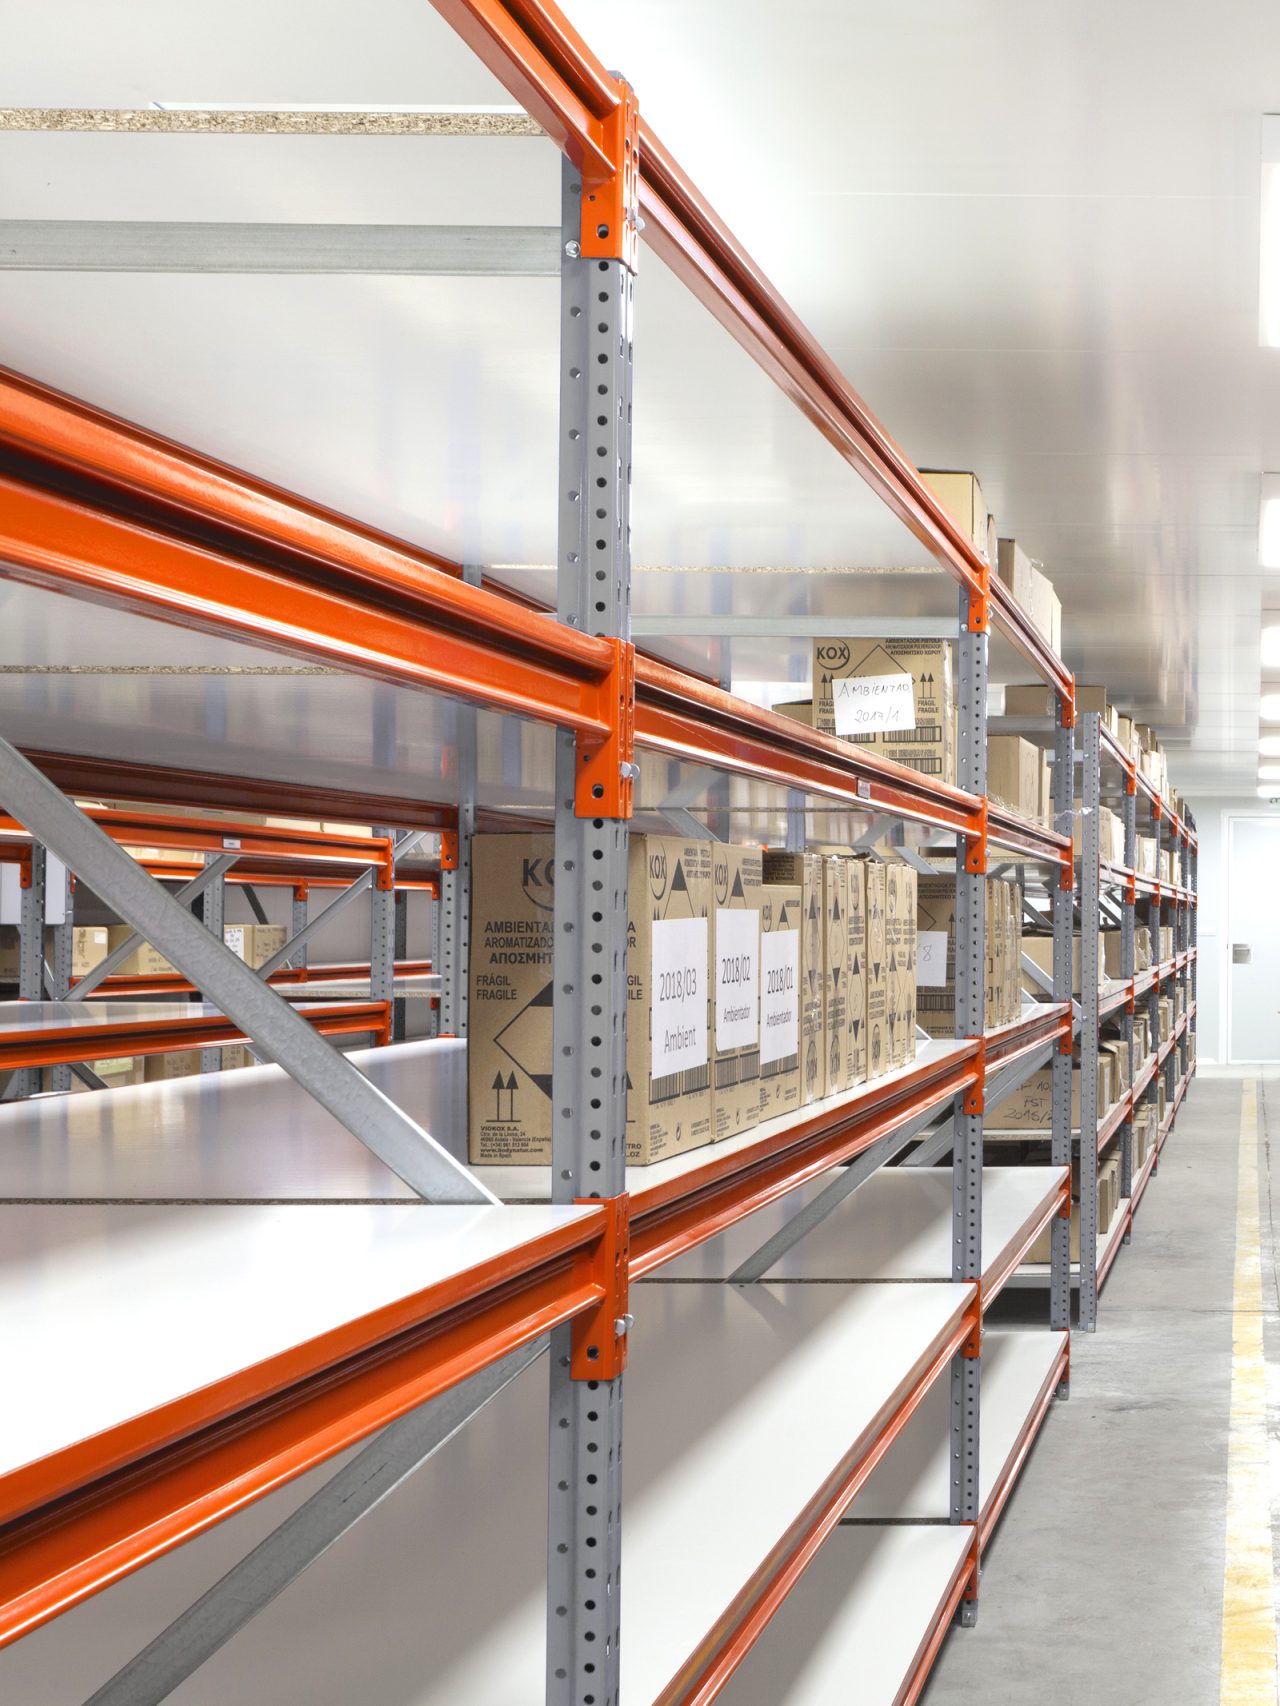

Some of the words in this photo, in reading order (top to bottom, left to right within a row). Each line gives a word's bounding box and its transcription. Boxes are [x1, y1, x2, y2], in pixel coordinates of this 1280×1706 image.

[816, 647, 848, 660] KOX
[650, 855, 665, 879] KOX
[485, 921, 553, 933] AMBIENTA
[476, 973, 511, 985] FRÁGIL
[722, 954, 751, 987] 2018/02
[767, 964, 793, 995] 2018/01
[476, 989, 517, 1000] FRAGILE
[660, 966, 697, 1002] 2018/03
[664, 1025, 697, 1053] Ambient
